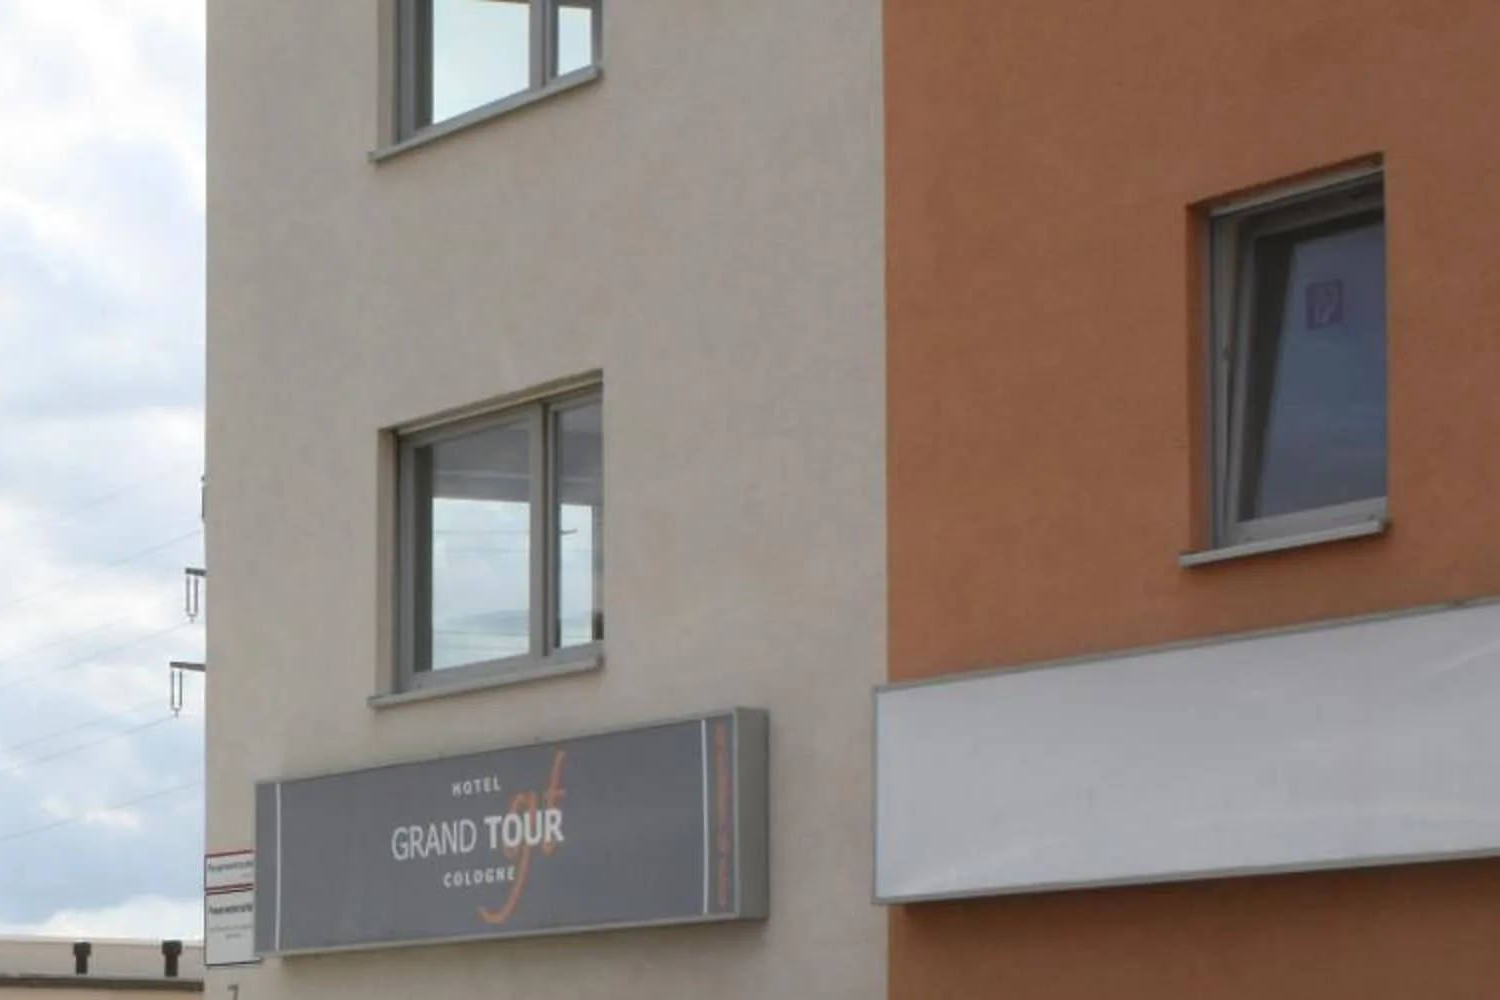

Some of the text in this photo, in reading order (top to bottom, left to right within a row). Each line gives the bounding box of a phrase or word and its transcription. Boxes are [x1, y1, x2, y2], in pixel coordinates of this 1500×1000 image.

[451, 774, 501, 797] HOTEL
[391, 808, 565, 861] GRAND TOUR
[442, 866, 516, 889] COLOGNE
